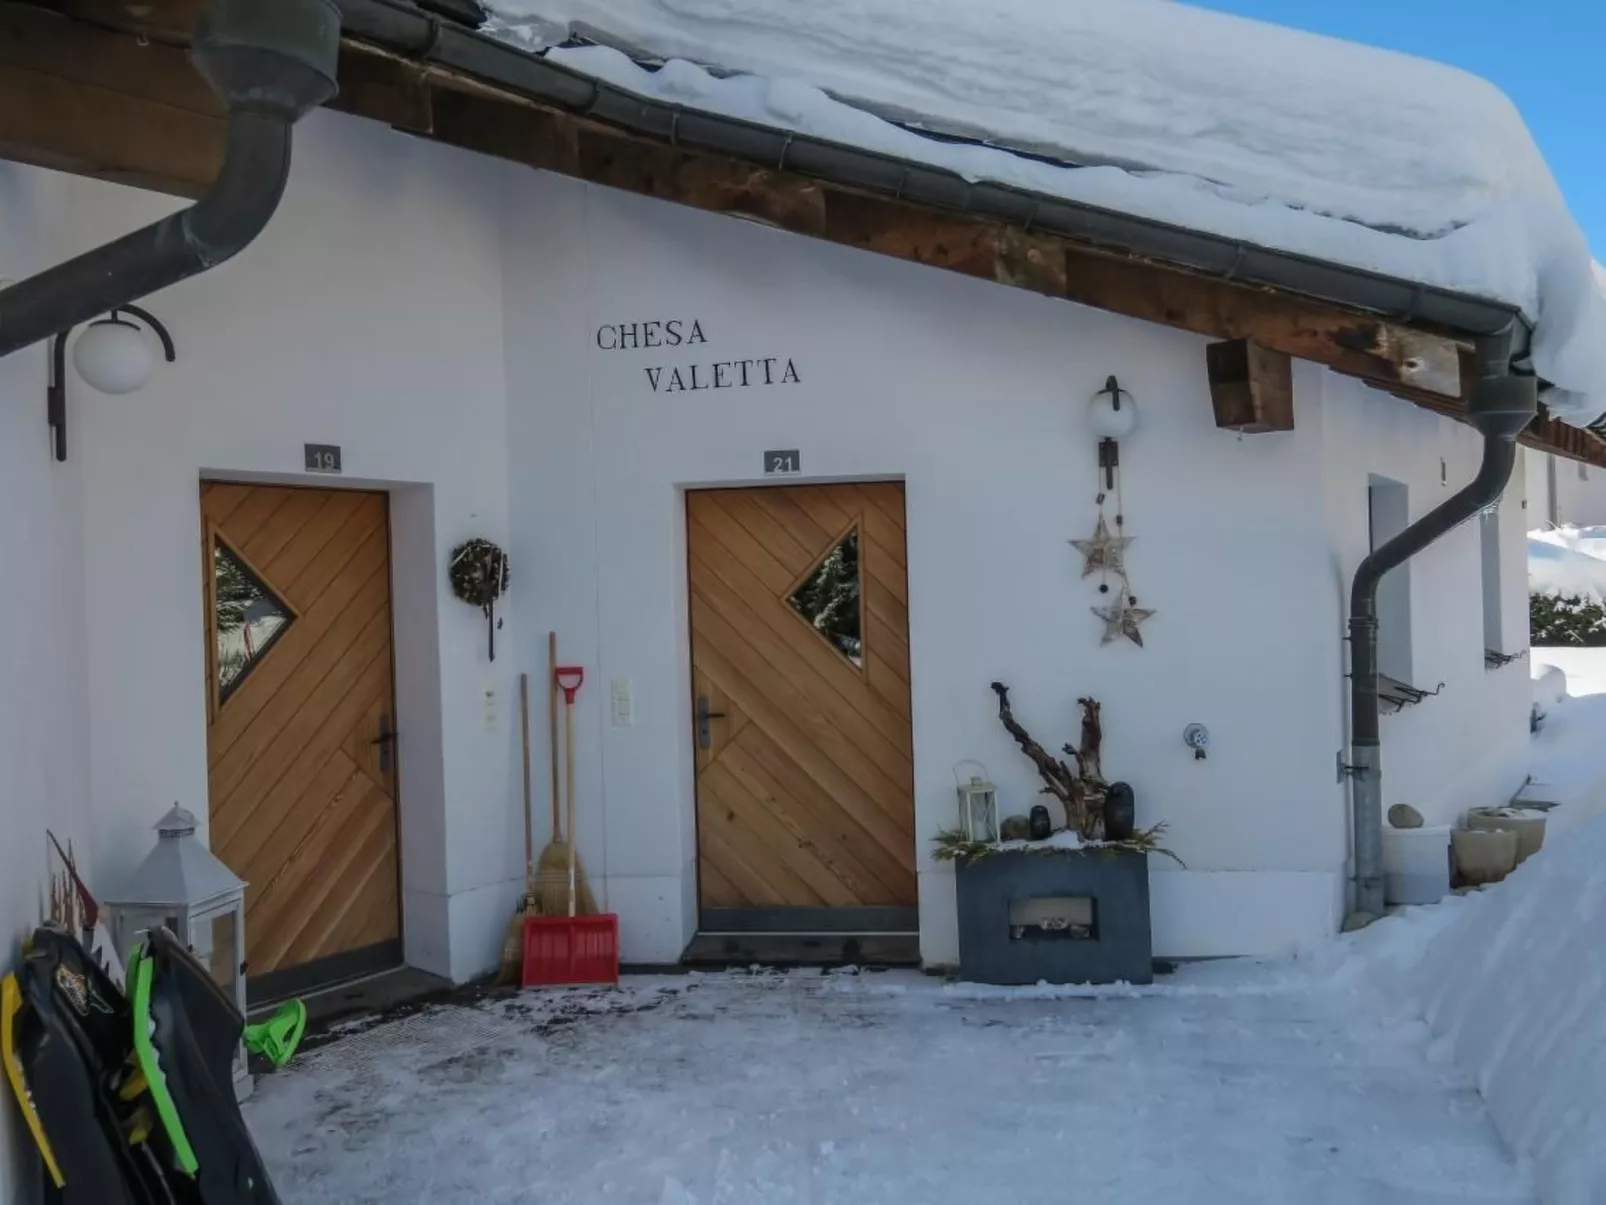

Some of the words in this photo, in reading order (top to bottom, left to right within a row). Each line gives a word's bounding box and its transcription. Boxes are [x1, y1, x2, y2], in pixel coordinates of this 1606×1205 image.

[596, 319, 708, 350] CHESA
[645, 357, 801, 392] VALETTA
[313, 451, 335, 470] 19
[773, 456, 792, 473] 21
